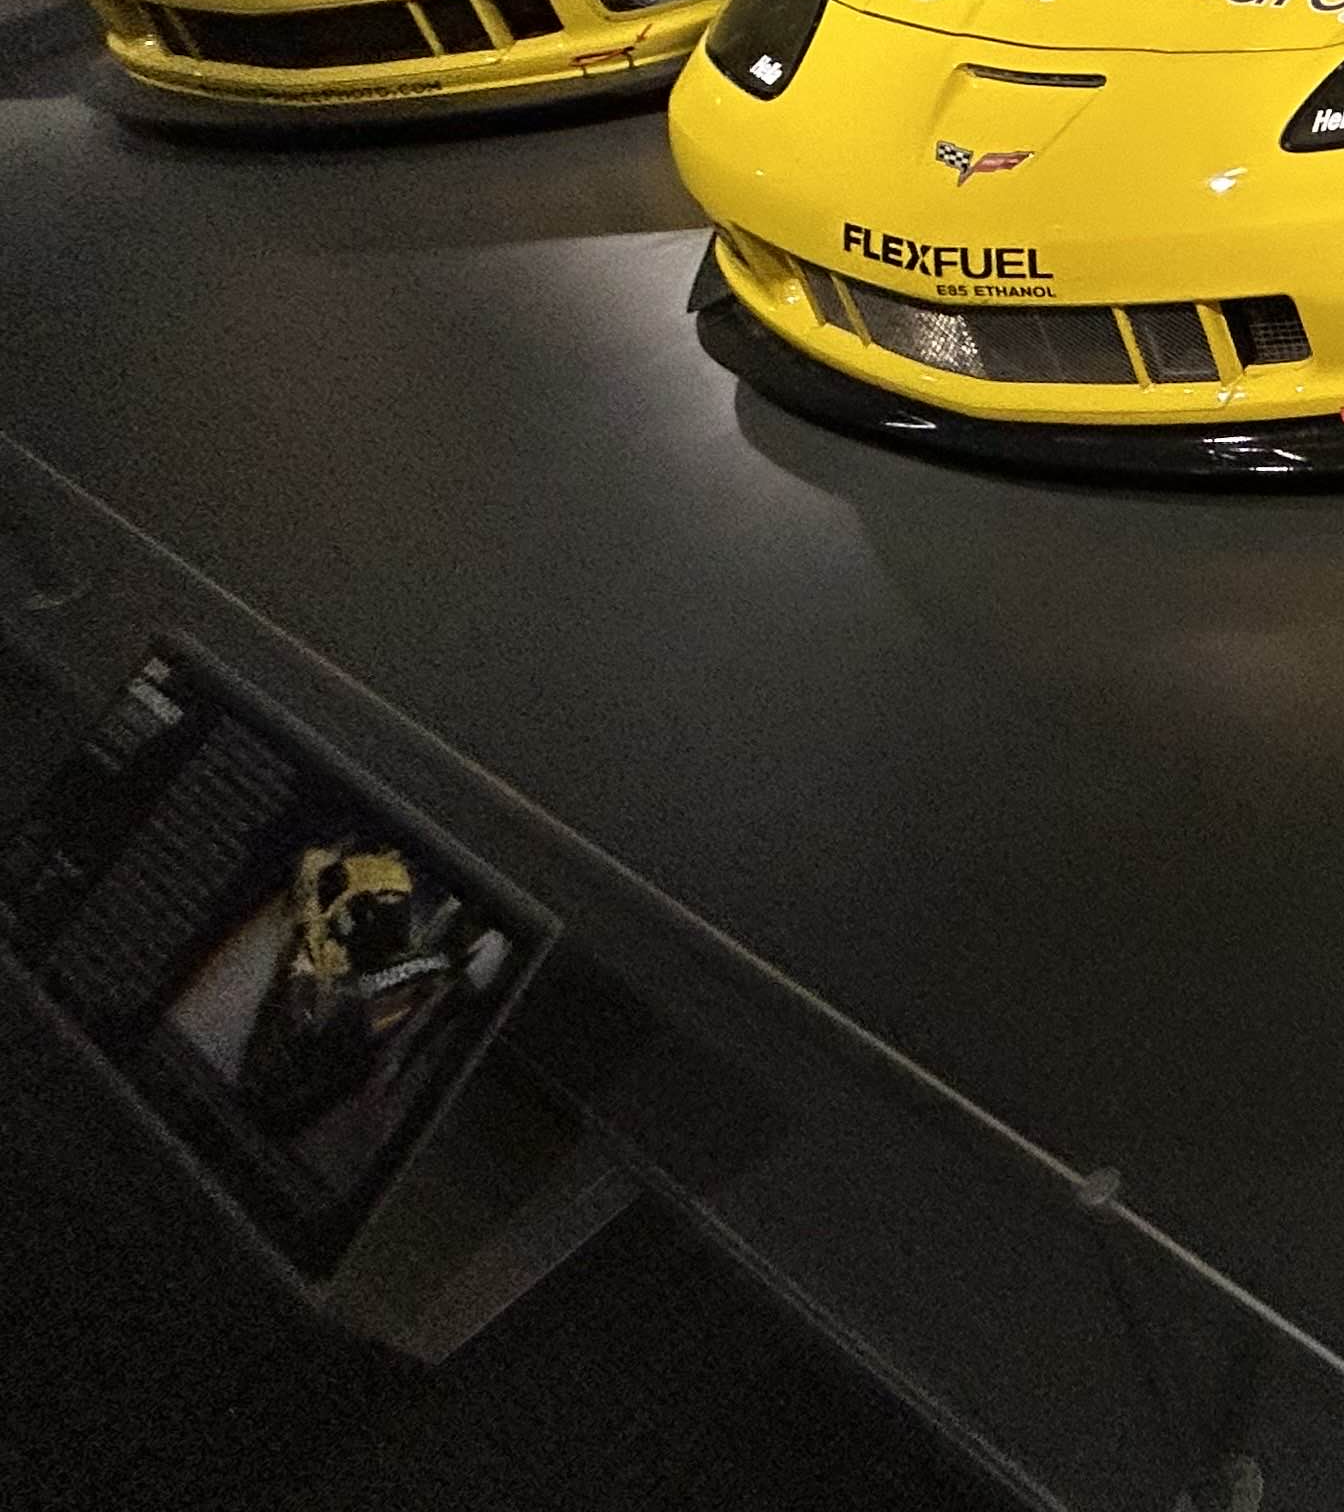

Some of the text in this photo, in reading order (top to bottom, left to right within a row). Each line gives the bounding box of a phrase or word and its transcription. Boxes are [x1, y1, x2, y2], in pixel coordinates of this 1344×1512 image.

[843, 222, 1054, 280] FLEXFUEL
[936, 284, 1057, 299] E85 ETHANOL
